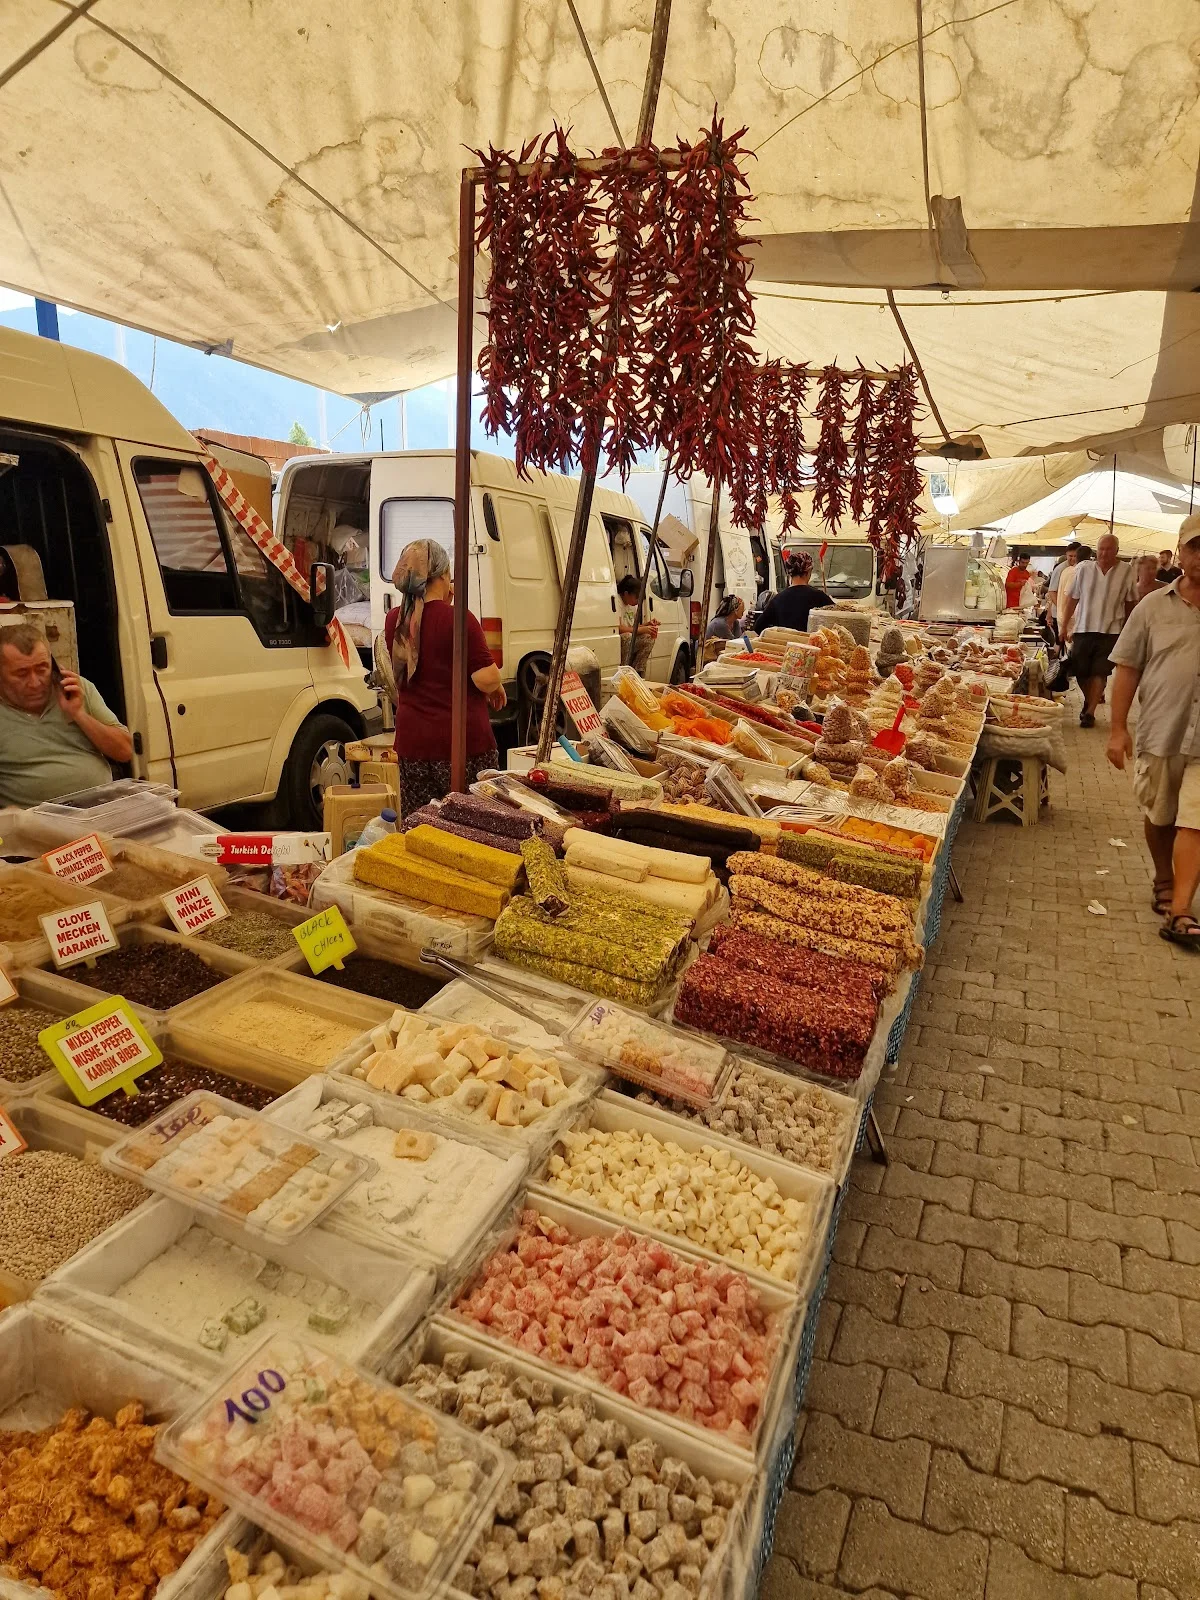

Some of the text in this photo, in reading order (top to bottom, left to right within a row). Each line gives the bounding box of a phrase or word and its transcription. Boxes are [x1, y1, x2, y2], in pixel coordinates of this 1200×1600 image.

[55, 843, 94, 866] BLACK PEPPER
[231, 845, 259, 855] Turkish
[260, 844, 291, 858] Delight
[55, 851, 105, 878] SCHWARZE PFEFFER
[175, 886, 201, 905] MINI
[176, 895, 212, 919] MİNZE
[57, 910, 92, 929] CLOVE
[185, 907, 217, 929] NANE
[56, 921, 101, 943] MECKEN
[57, 932, 110, 958] KARANFİL
[65, 1014, 123, 1052] MIXED PEPPER
[71, 1027, 136, 1068] MUSHE PFEFFER
[84, 1055, 121, 1082] KARIŞIK
[224, 1369, 287, 1425] 100
